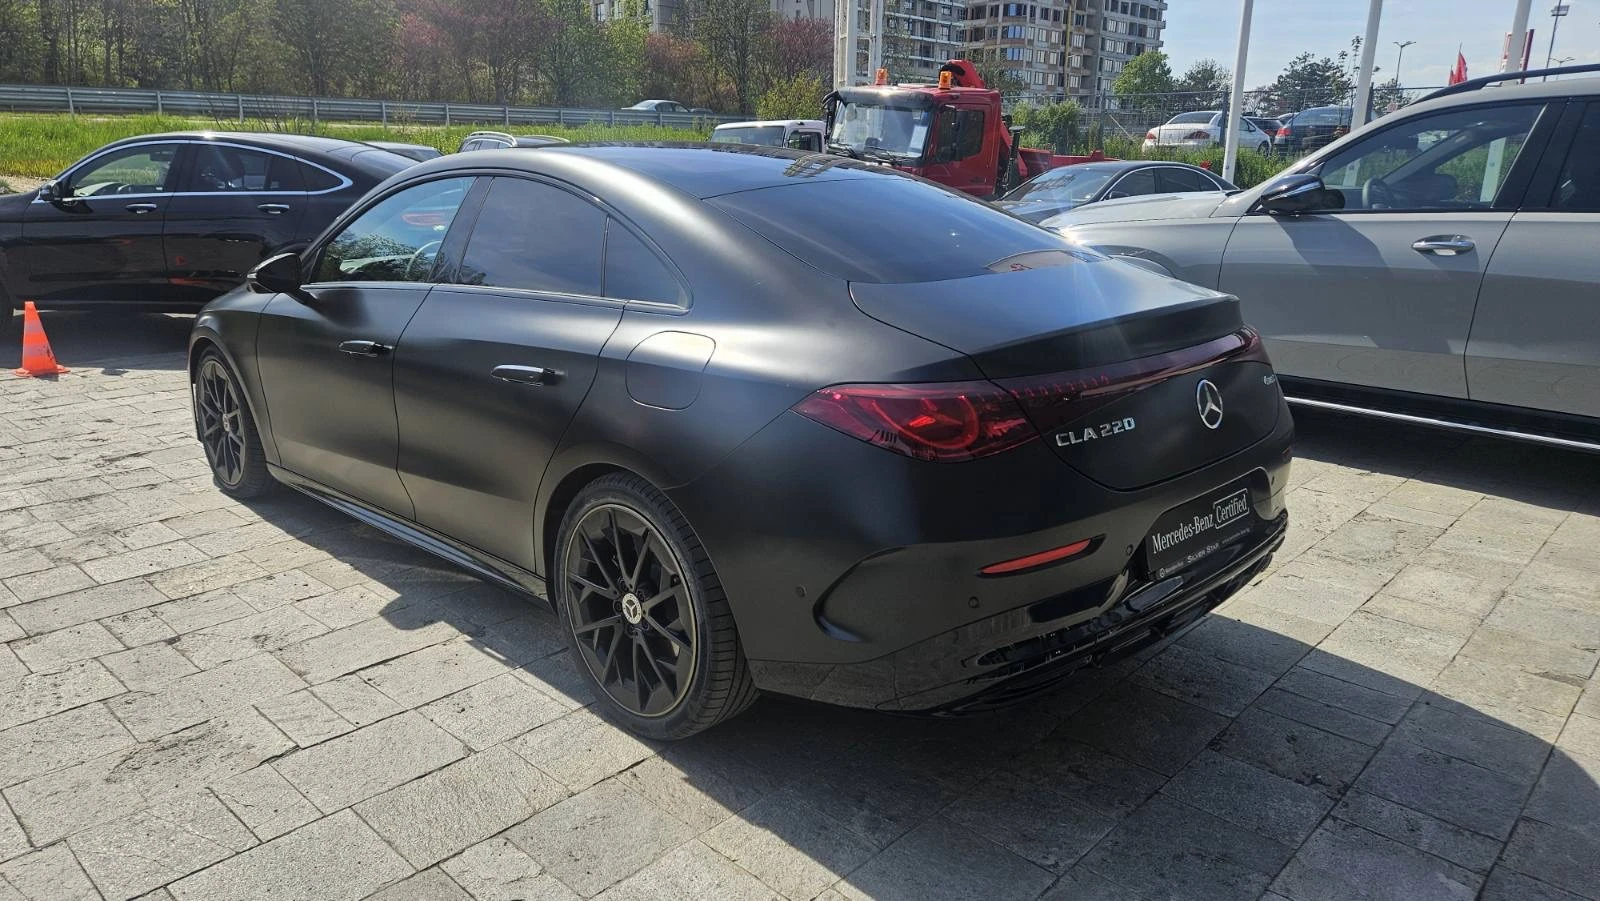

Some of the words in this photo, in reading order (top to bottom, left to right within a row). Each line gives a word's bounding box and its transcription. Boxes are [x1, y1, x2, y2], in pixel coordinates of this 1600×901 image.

[1055, 427, 1098, 447] CLA
[1099, 417, 1136, 437] 220
[1152, 513, 1214, 554] Mercedes-Benz
[1215, 494, 1248, 523] Certified
